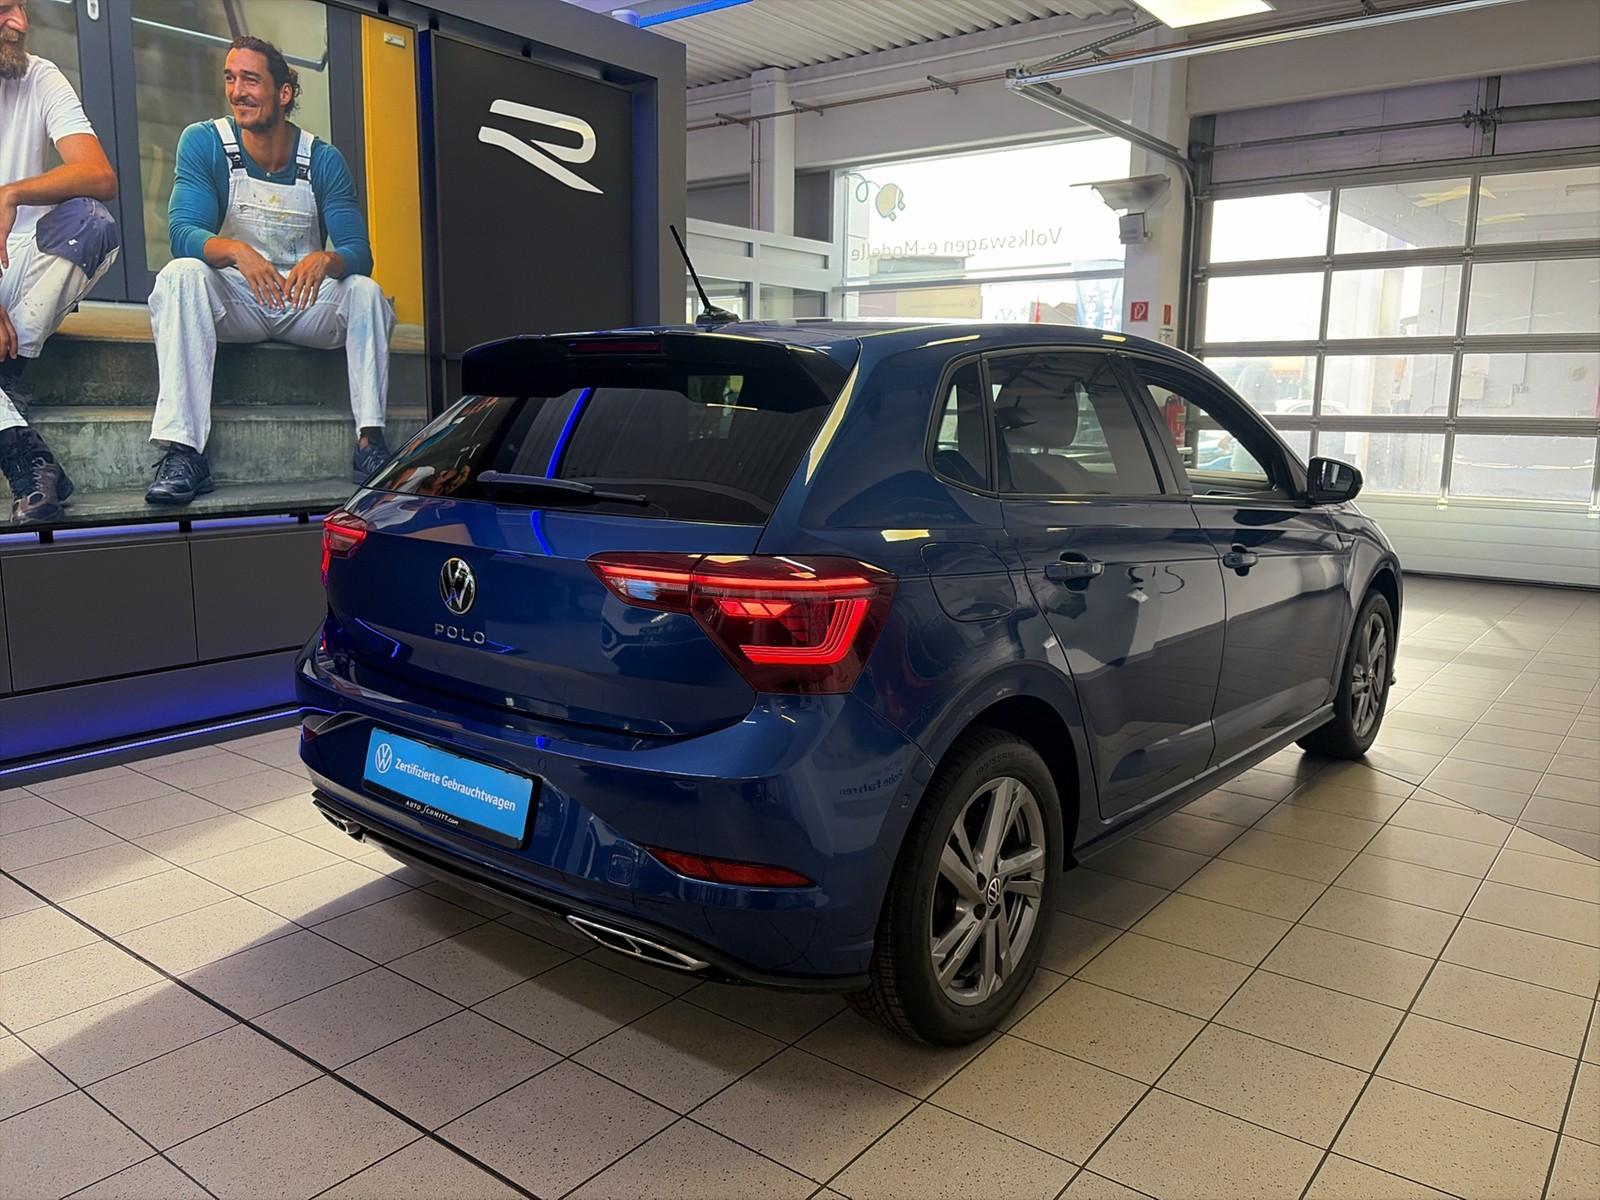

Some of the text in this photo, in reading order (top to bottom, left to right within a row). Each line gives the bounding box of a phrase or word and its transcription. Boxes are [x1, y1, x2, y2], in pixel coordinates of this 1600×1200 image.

[434, 623, 486, 645] POLO
[394, 757, 516, 812] Zertifizierte Gebrauchtwagen
[405, 800, 422, 811] AUTO
